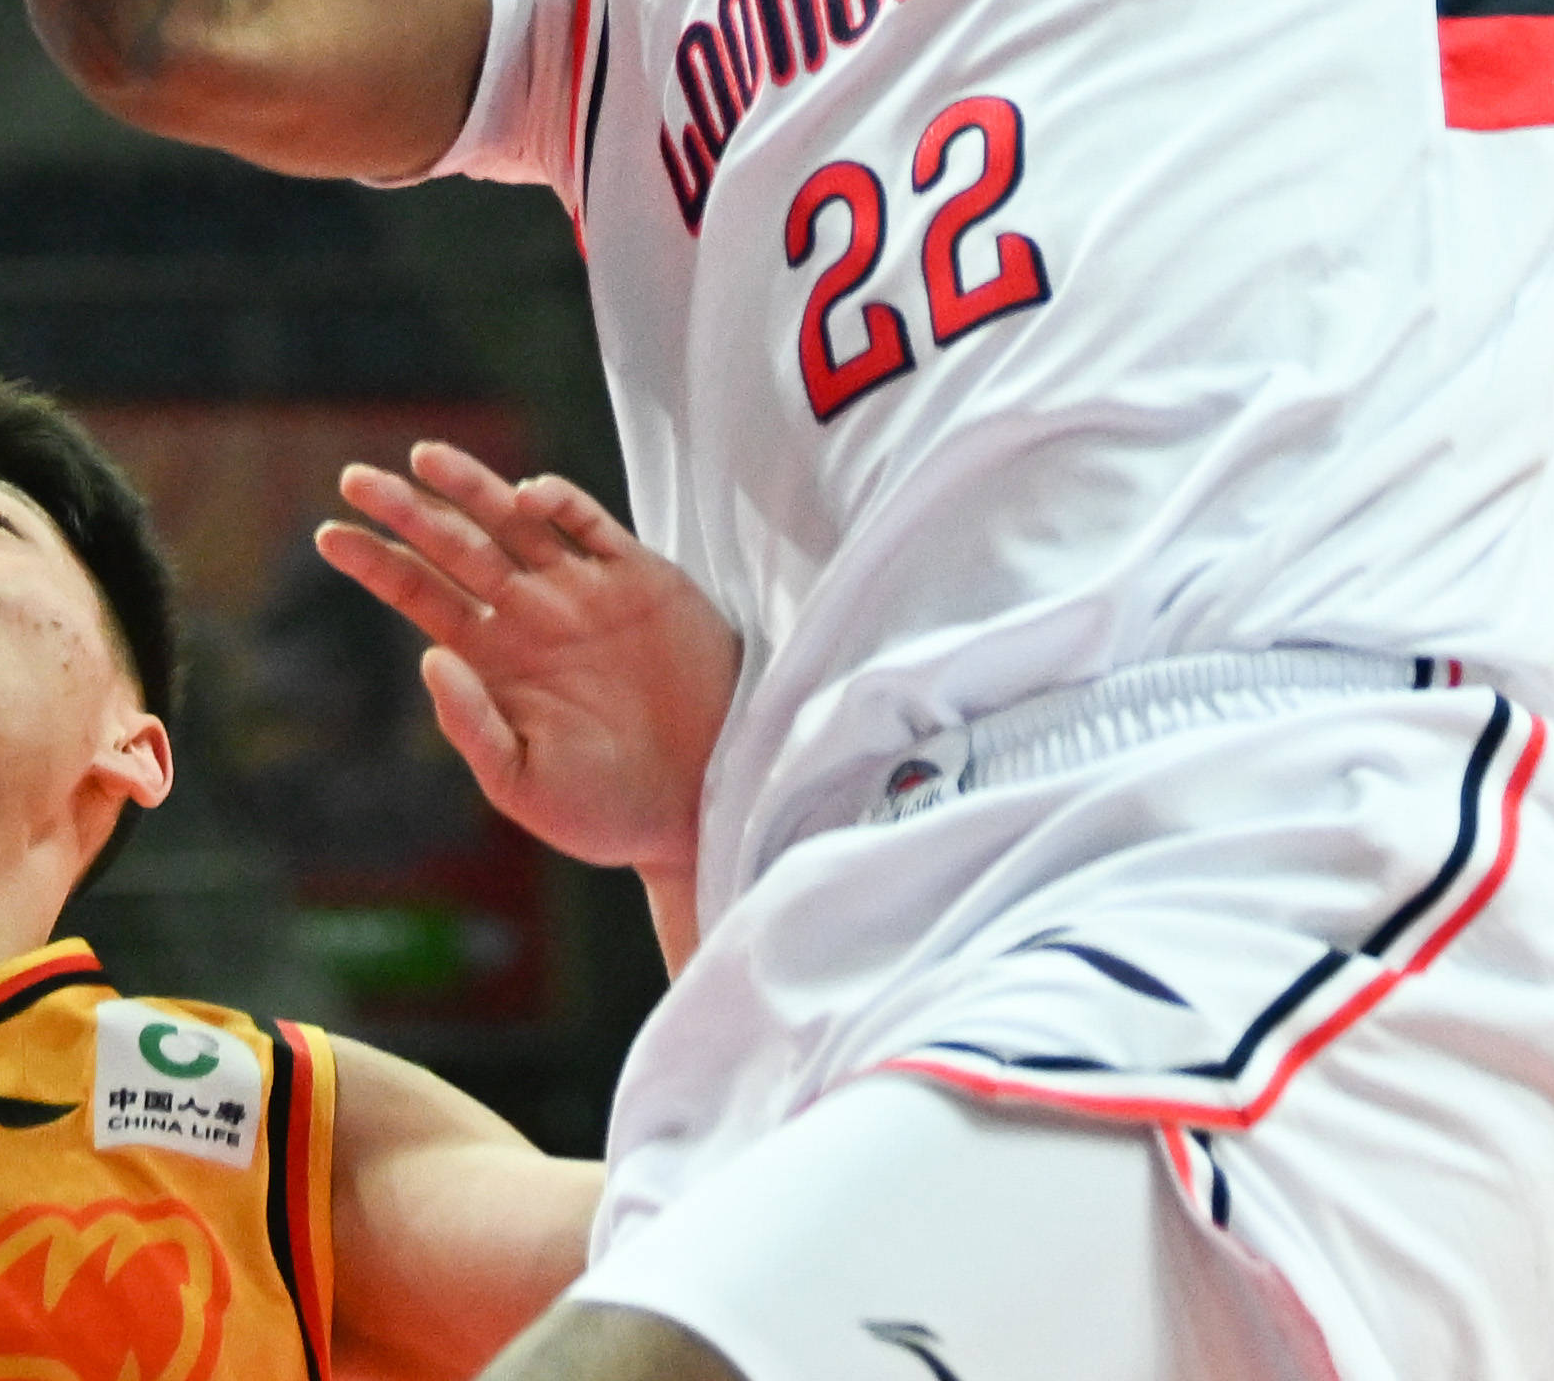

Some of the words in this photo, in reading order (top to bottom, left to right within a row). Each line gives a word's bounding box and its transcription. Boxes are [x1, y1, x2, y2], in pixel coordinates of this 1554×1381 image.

[784, 95, 1052, 426] 22
[108, 1116, 183, 1136] CHINA
[192, 1124, 241, 1148] LIFE
